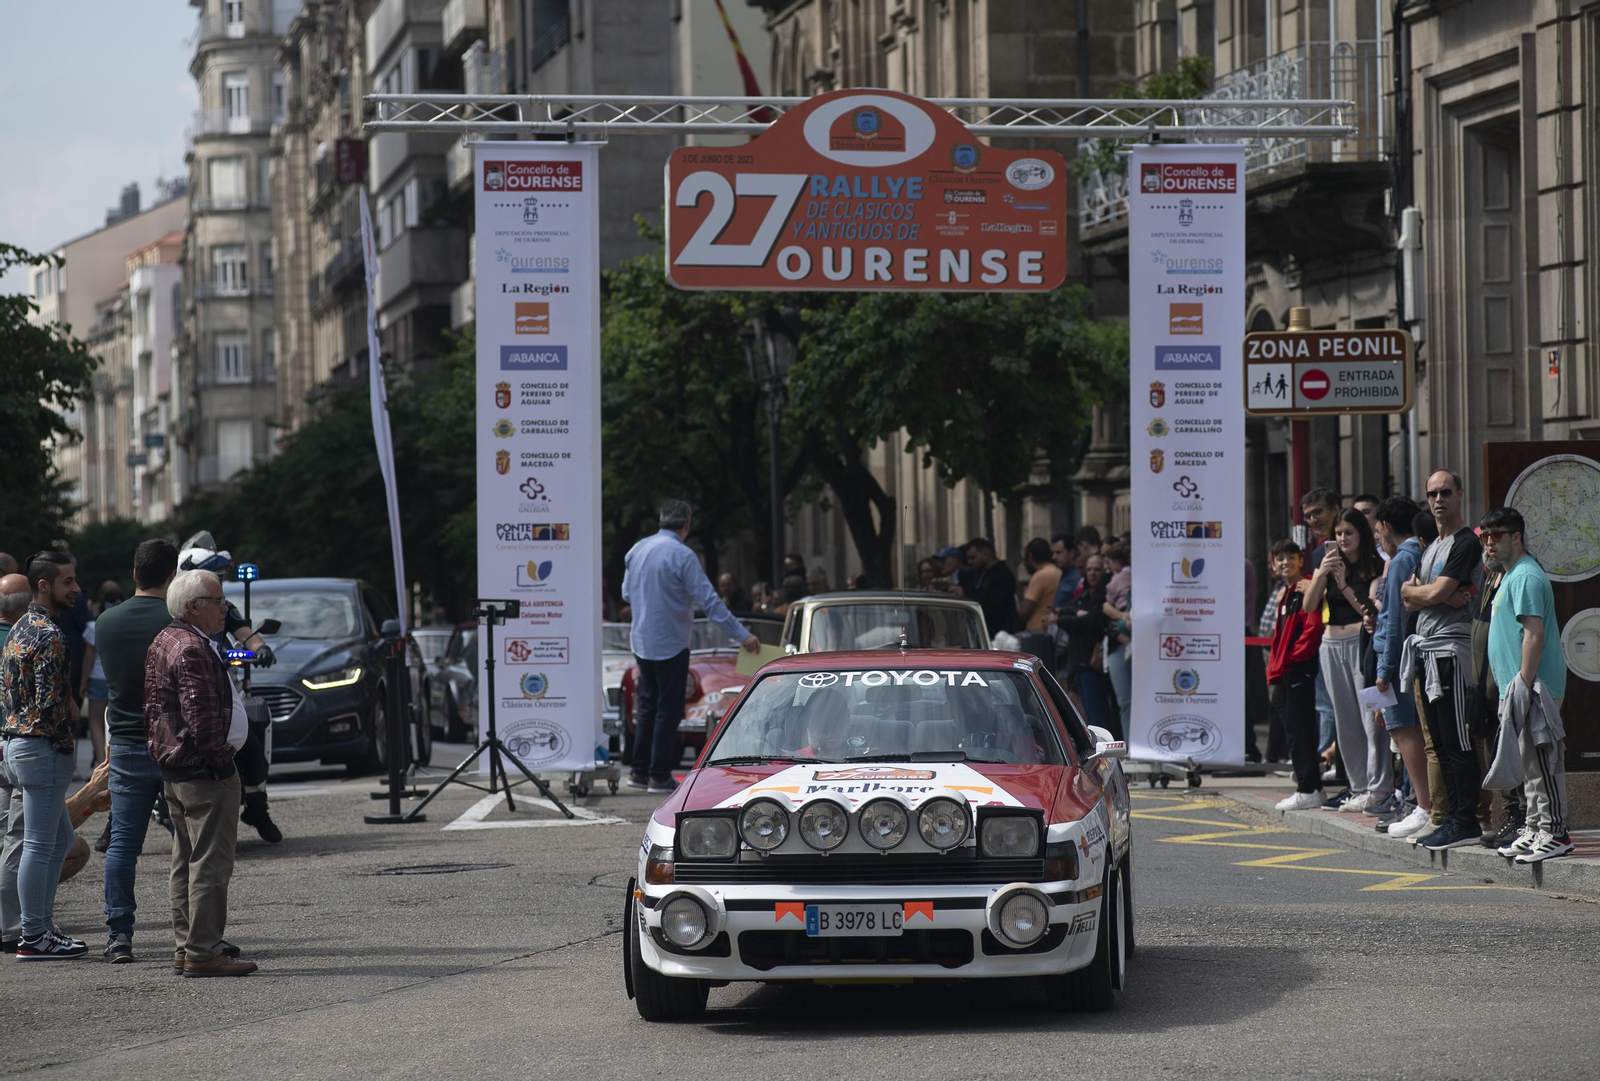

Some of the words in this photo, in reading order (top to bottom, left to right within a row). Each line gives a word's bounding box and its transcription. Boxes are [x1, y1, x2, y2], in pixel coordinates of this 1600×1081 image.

[867, 142, 902, 150] Ourense
[682, 154, 687, 163] 3
[688, 155, 698, 163] DE
[700, 155, 722, 163] JUNIO
[724, 155, 734, 164] DE
[737, 155, 754, 164] 2023
[508, 164, 553, 174] Concello
[556, 165, 569, 174] de
[1164, 166, 1208, 176] Concello
[1212, 167, 1224, 176] de
[507, 176, 581, 188] OURENSE
[810, 174, 923, 199] RALLYE
[1164, 178, 1235, 190] OURENSE
[806, 201, 830, 219] DE
[832, 202, 915, 220] CLASICOS
[673, 170, 809, 266] 27
[793, 222, 804, 238] Y
[805, 222, 894, 240] ANTIGUOS
[897, 224, 920, 241] DE
[981, 223, 995, 231] La
[511, 257, 569, 268] ourense
[777, 246, 1043, 284] OURENSE
[1166, 258, 1223, 269] ourense
[502, 283, 520, 293] La
[1157, 284, 1174, 294] La
[1248, 339, 1310, 358] ZONA
[1319, 337, 1402, 357] PEONIL
[1339, 370, 1394, 381] ENTRADA
[1334, 386, 1399, 398] PROHIBIDA
[496, 523, 531, 532] PONTE
[1151, 521, 1186, 530] PONTE
[497, 532, 531, 541] VELLA
[1151, 530, 1186, 538] VELLA
[840, 670, 988, 687] TOYOTA
[688, 705, 709, 720] 27
[820, 912, 829, 929] B
[835, 912, 875, 929] 3978
[1067, 910, 1096, 935] PIRELLI
